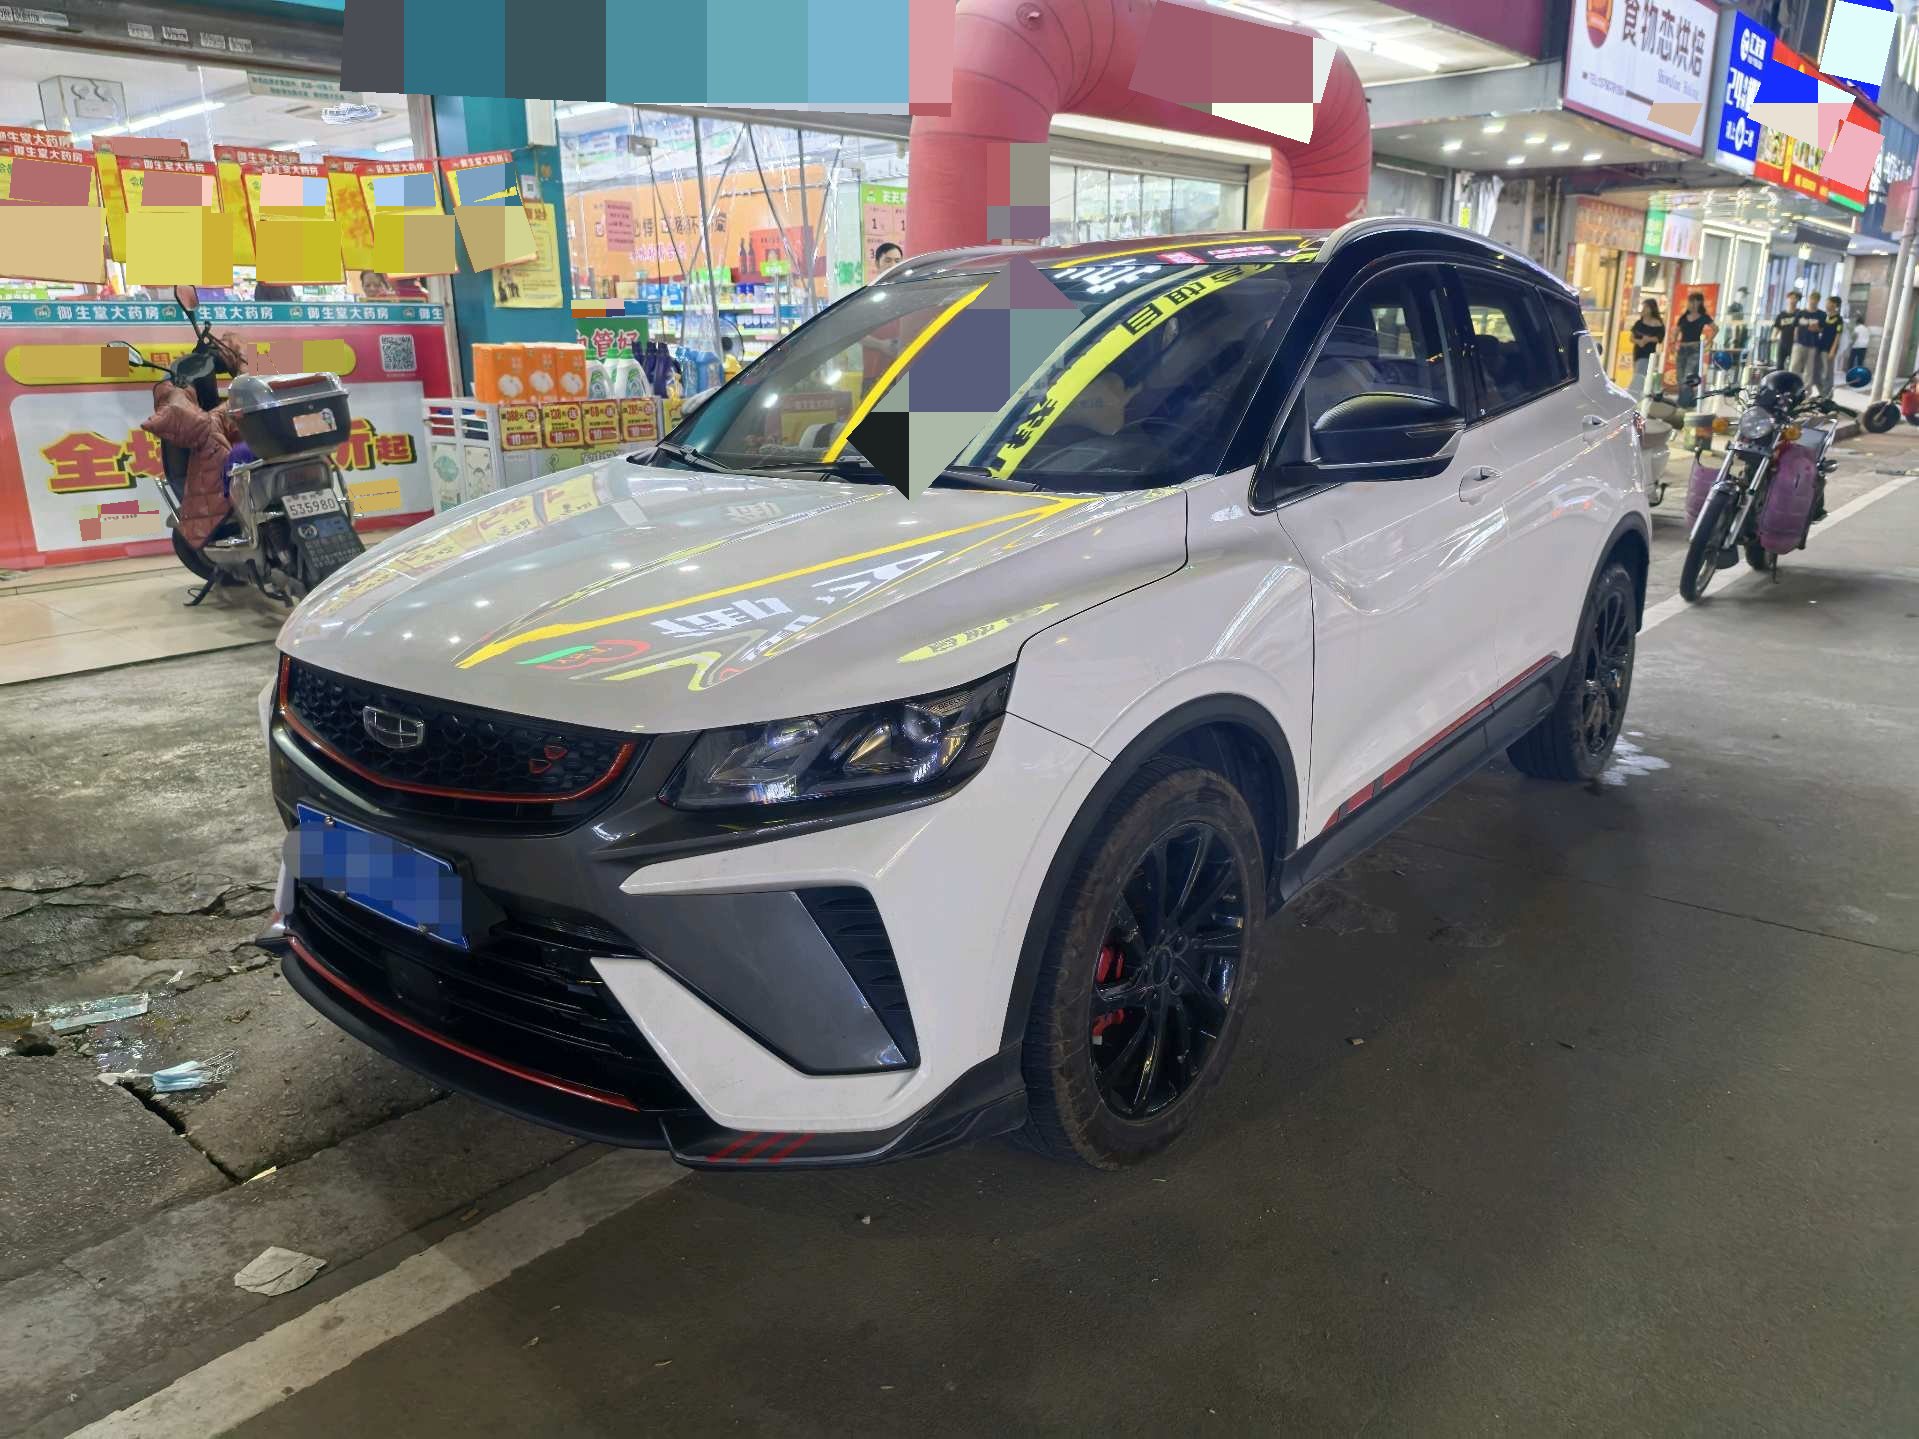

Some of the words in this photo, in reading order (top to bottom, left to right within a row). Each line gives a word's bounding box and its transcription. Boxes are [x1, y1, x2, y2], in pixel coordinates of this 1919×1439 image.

[14, 145, 83, 163] 御生堂大药房
[144, 159, 206, 174] 御生堂大药房
[57, 305, 159, 321] 御生堂大药房
[183, 305, 273, 320] 生堂大药房
[307, 306, 389, 320] 御生堂大药房
[419, 307, 443, 320] 御生
[289, 497, 336, 516] 535980
